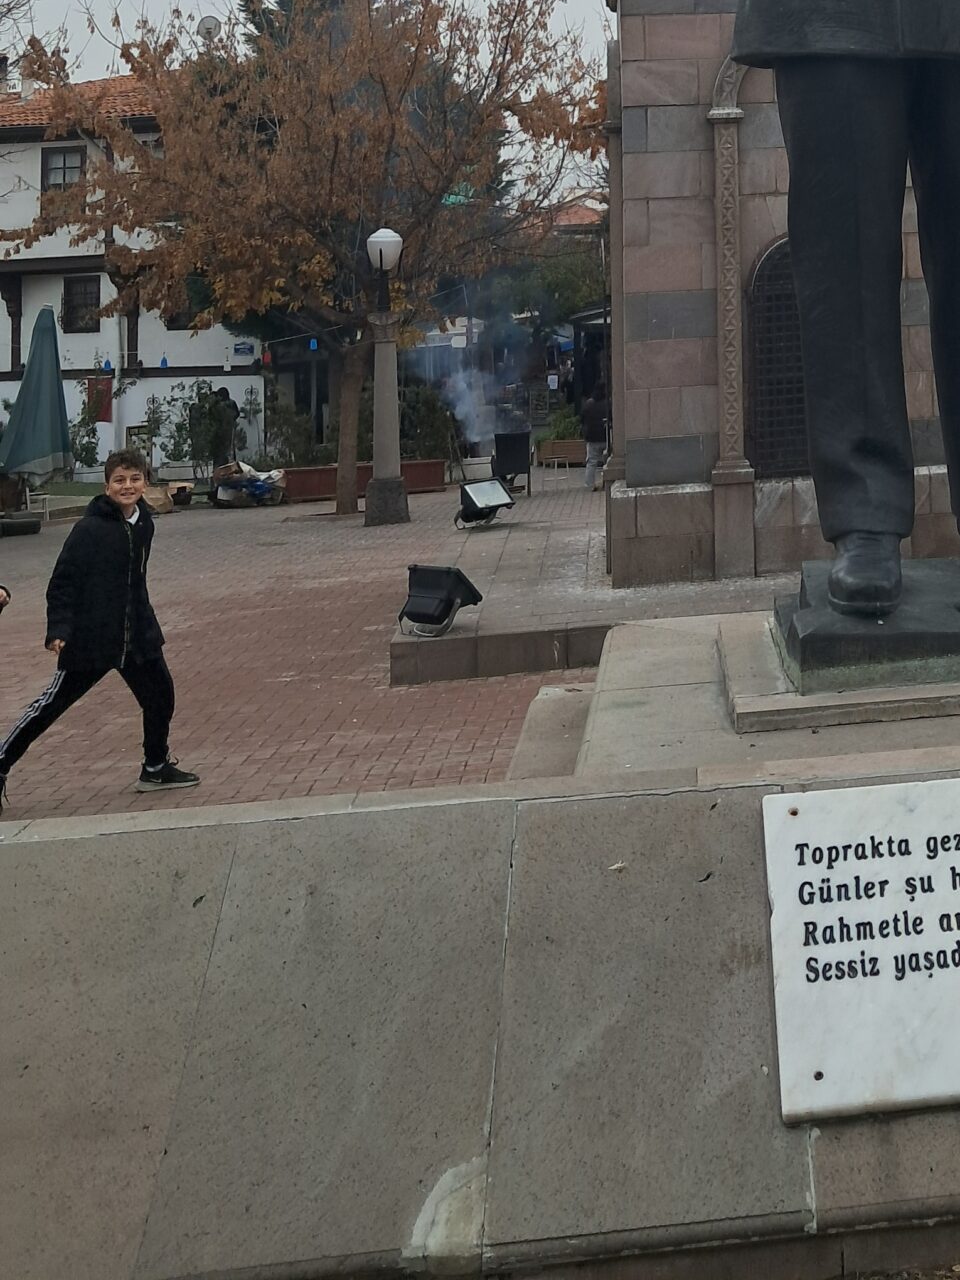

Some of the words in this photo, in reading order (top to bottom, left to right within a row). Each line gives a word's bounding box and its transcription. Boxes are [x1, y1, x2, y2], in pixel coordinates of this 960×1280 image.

[795, 836, 912, 870] Toprakta
[798, 875, 890, 906] Günler
[904, 875, 935, 902] şu
[802, 909, 924, 947] Rahmetle
[805, 950, 881, 984] Sessiz
